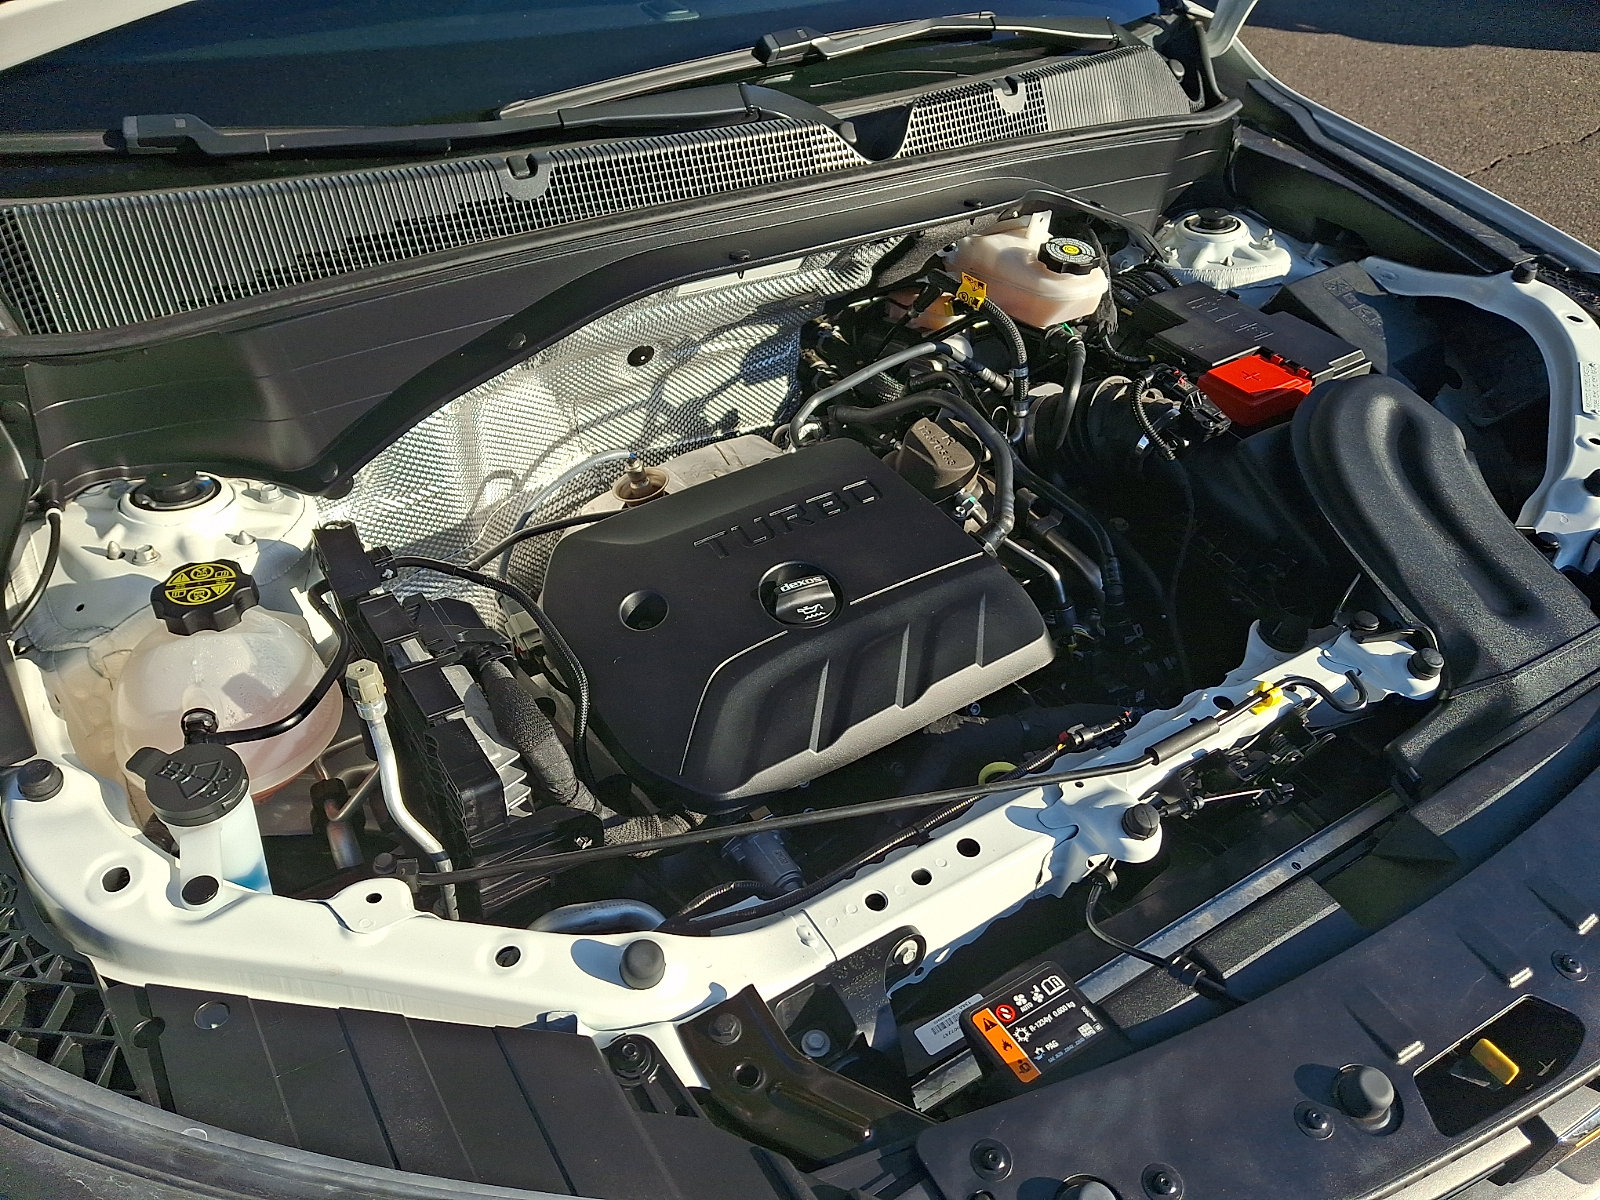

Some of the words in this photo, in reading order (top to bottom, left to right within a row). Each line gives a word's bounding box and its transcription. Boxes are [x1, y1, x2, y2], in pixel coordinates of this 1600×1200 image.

[693, 479, 884, 560] TURBO
[780, 575, 823, 593] dexos
[1019, 1002, 1034, 1013] AUTO
[1045, 1040, 1060, 1051] PAG
